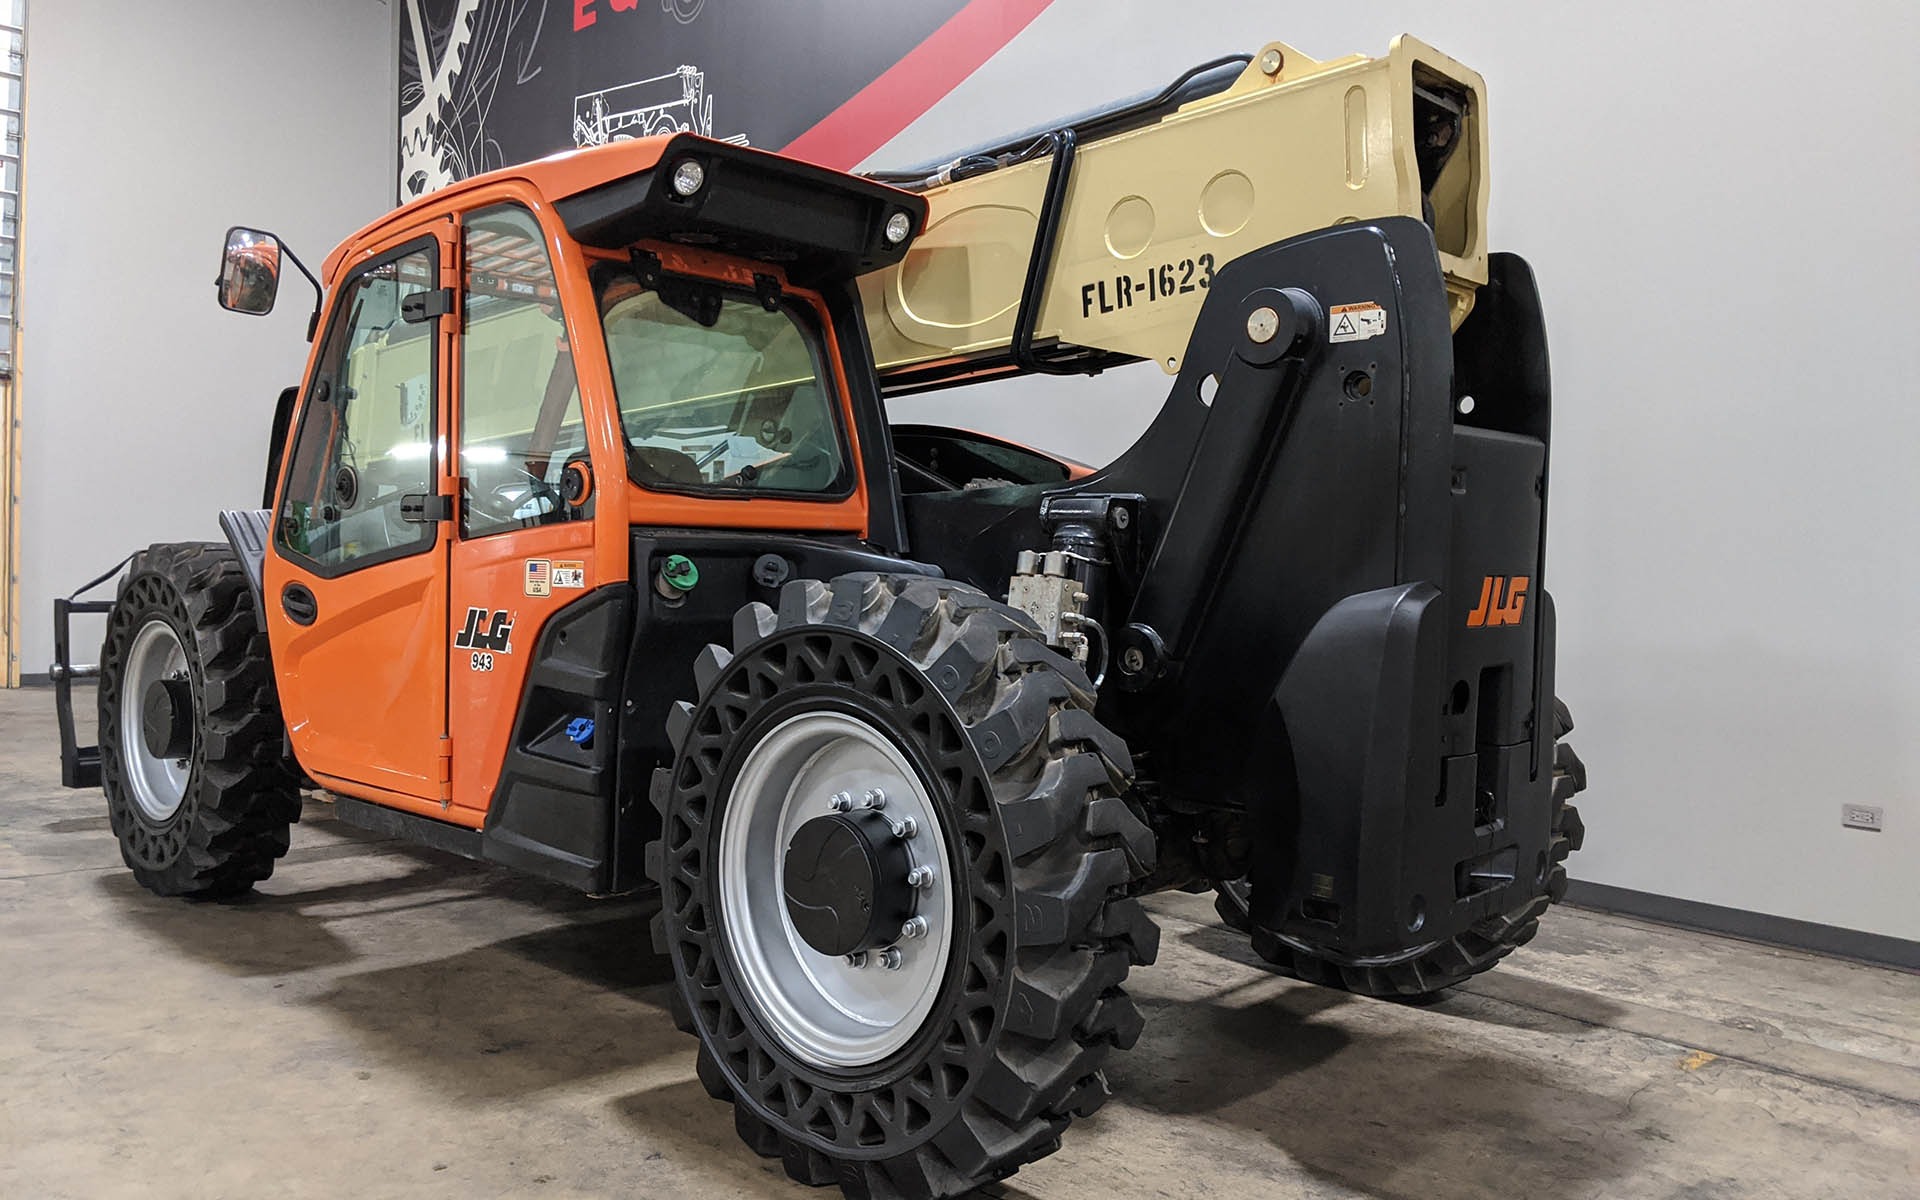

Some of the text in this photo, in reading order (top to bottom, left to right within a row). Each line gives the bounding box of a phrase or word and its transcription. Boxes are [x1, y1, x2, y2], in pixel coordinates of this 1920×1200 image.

[1082, 252, 1216, 318] FLR-1623
[1466, 577, 1530, 627] JLG
[455, 608, 513, 653] JLG
[472, 653, 493, 669] 943
